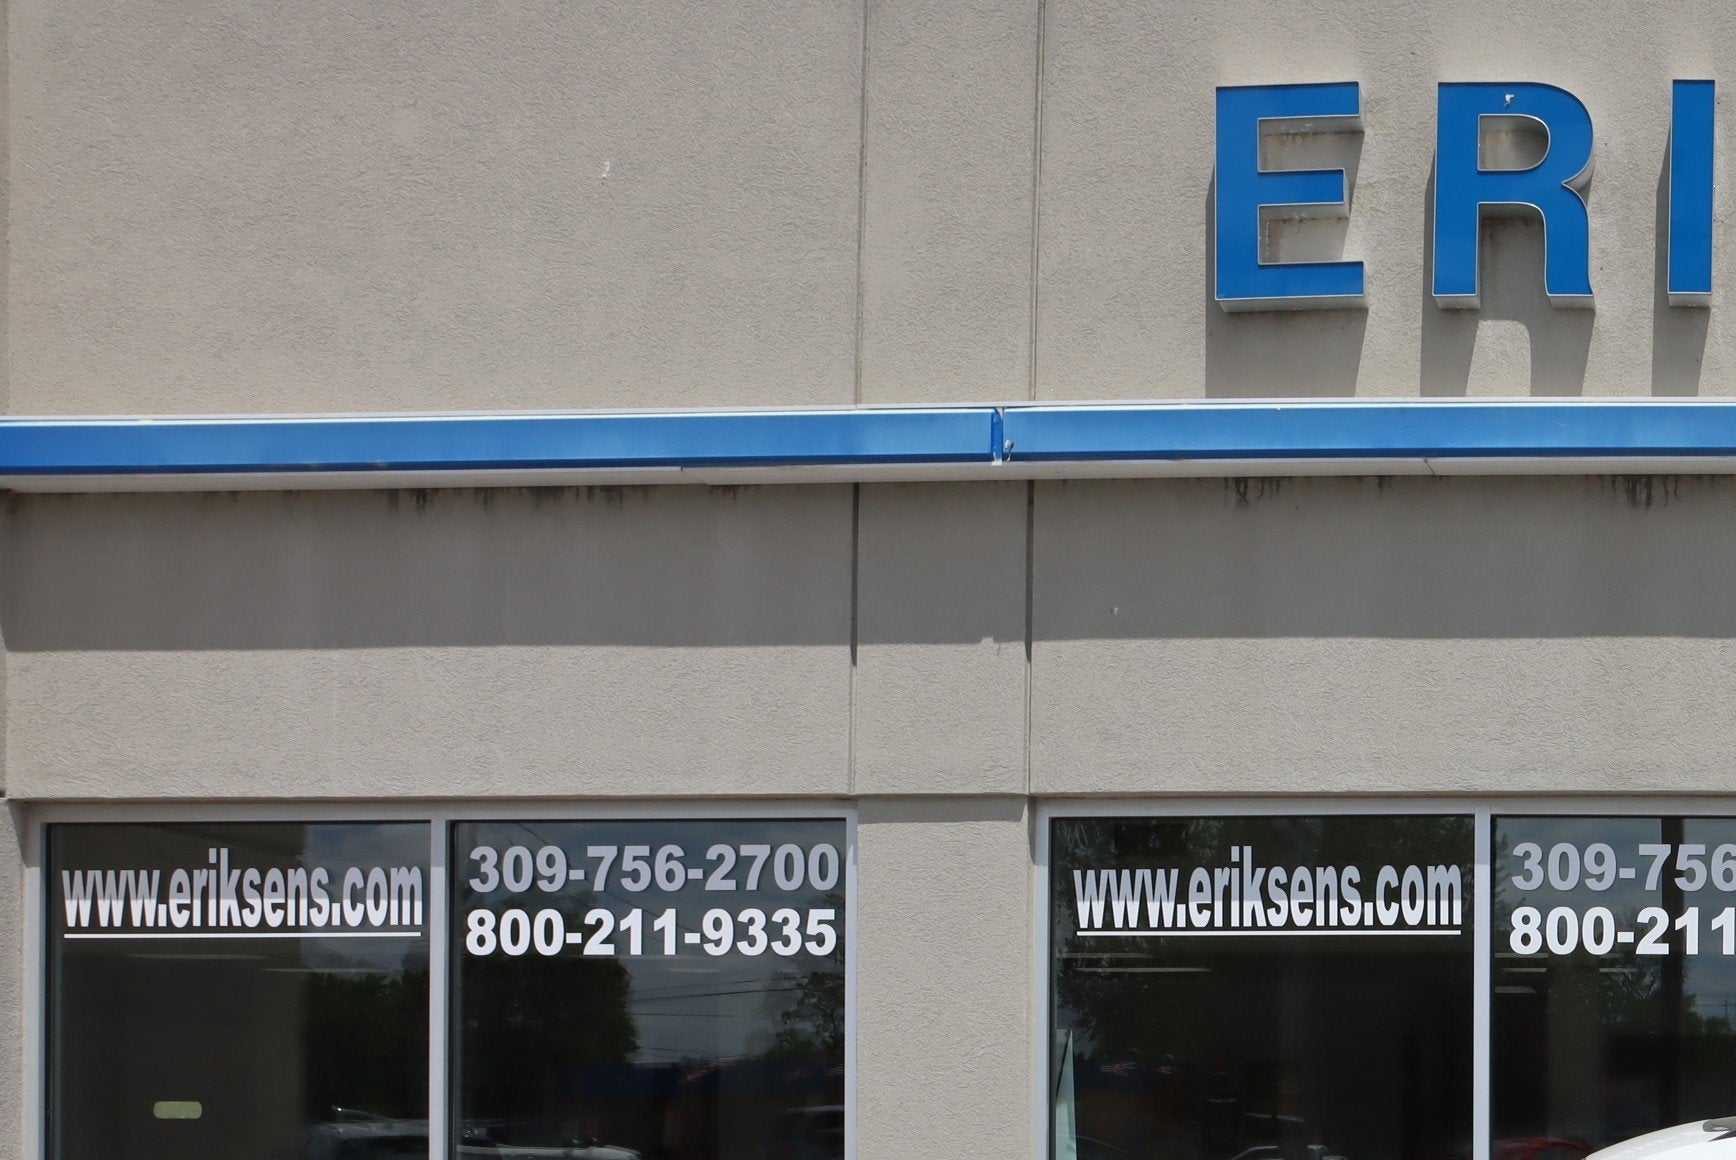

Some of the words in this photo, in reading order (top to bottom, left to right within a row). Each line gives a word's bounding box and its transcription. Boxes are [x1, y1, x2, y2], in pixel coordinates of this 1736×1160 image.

[61, 848, 424, 929] www.eriksens.com
[468, 843, 841, 894] 309-756-2700
[1073, 845, 1463, 930] www.eriksens.com
[465, 907, 839, 957] 800-211-9335
